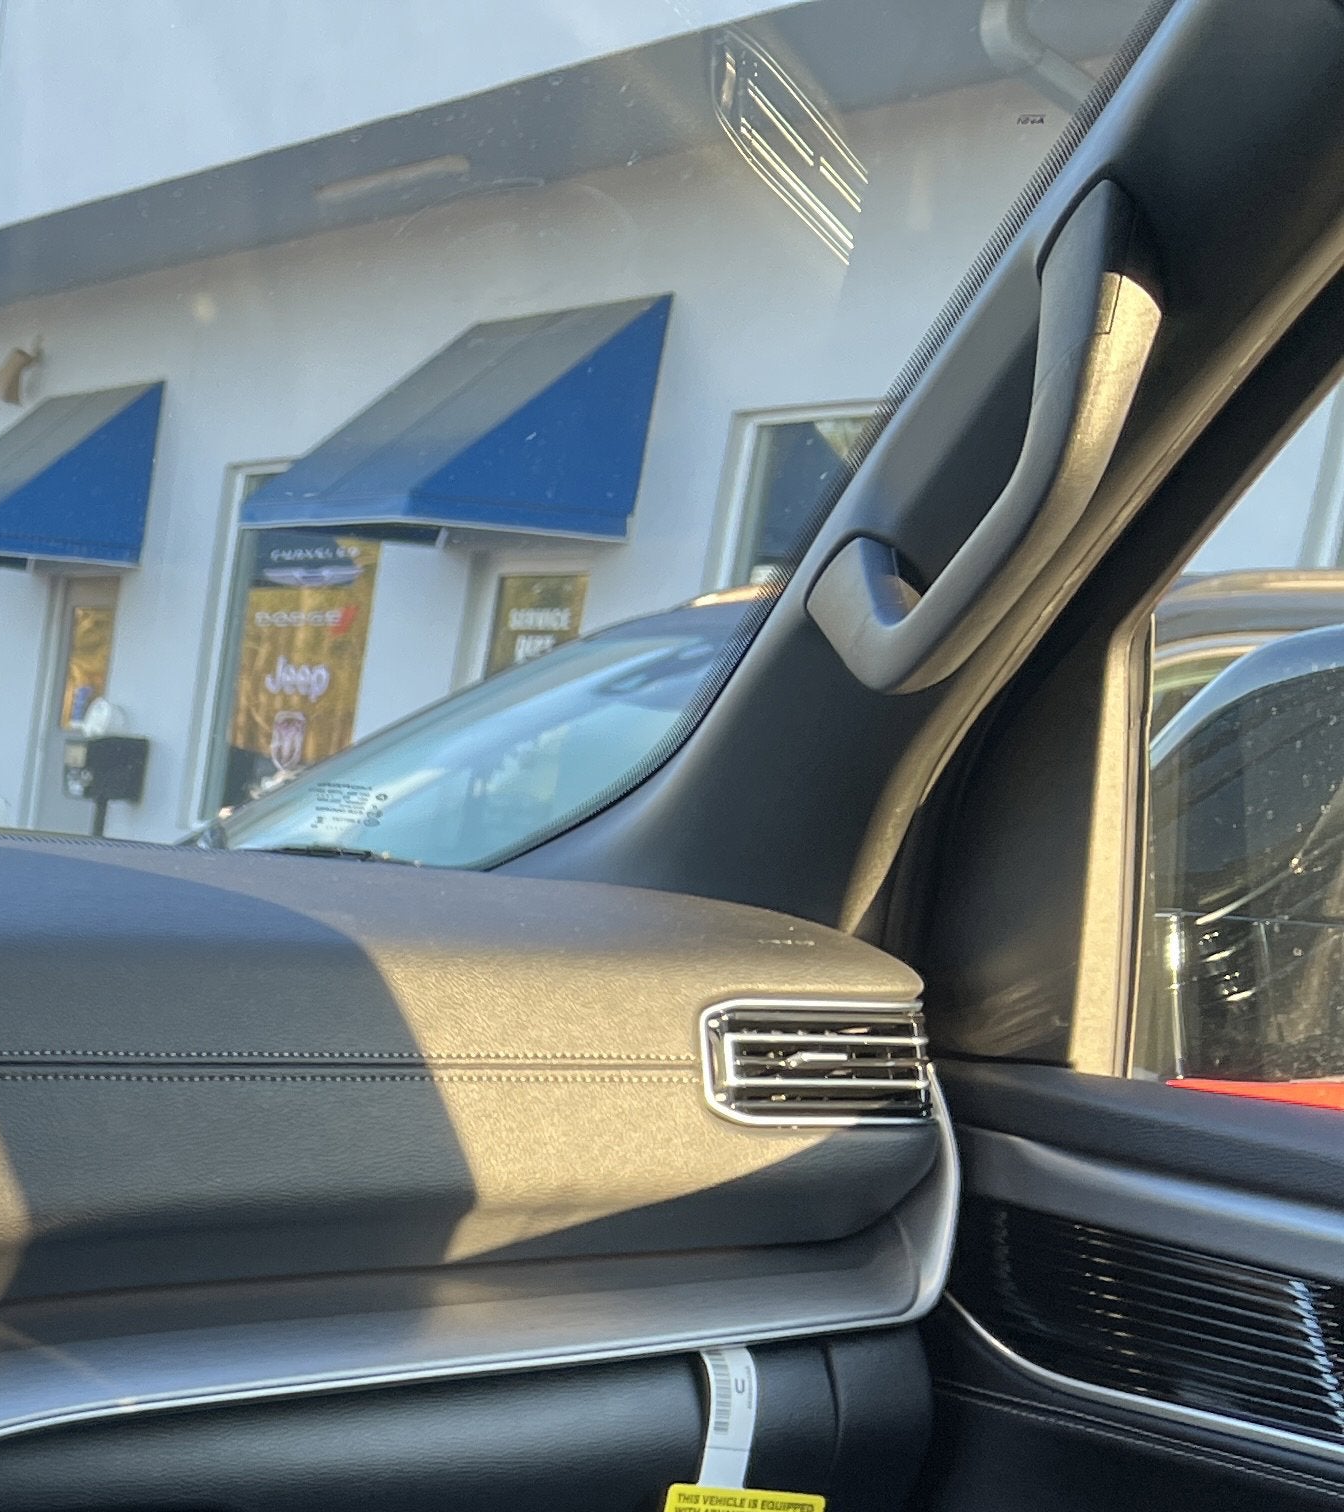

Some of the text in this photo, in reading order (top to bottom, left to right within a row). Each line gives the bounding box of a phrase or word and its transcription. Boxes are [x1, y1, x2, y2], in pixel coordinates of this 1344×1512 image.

[264, 655, 330, 703] Jeep
[677, 1492, 700, 1505] THIS
[702, 1494, 746, 1508] VEHICLE
[747, 1498, 759, 1508] IS
